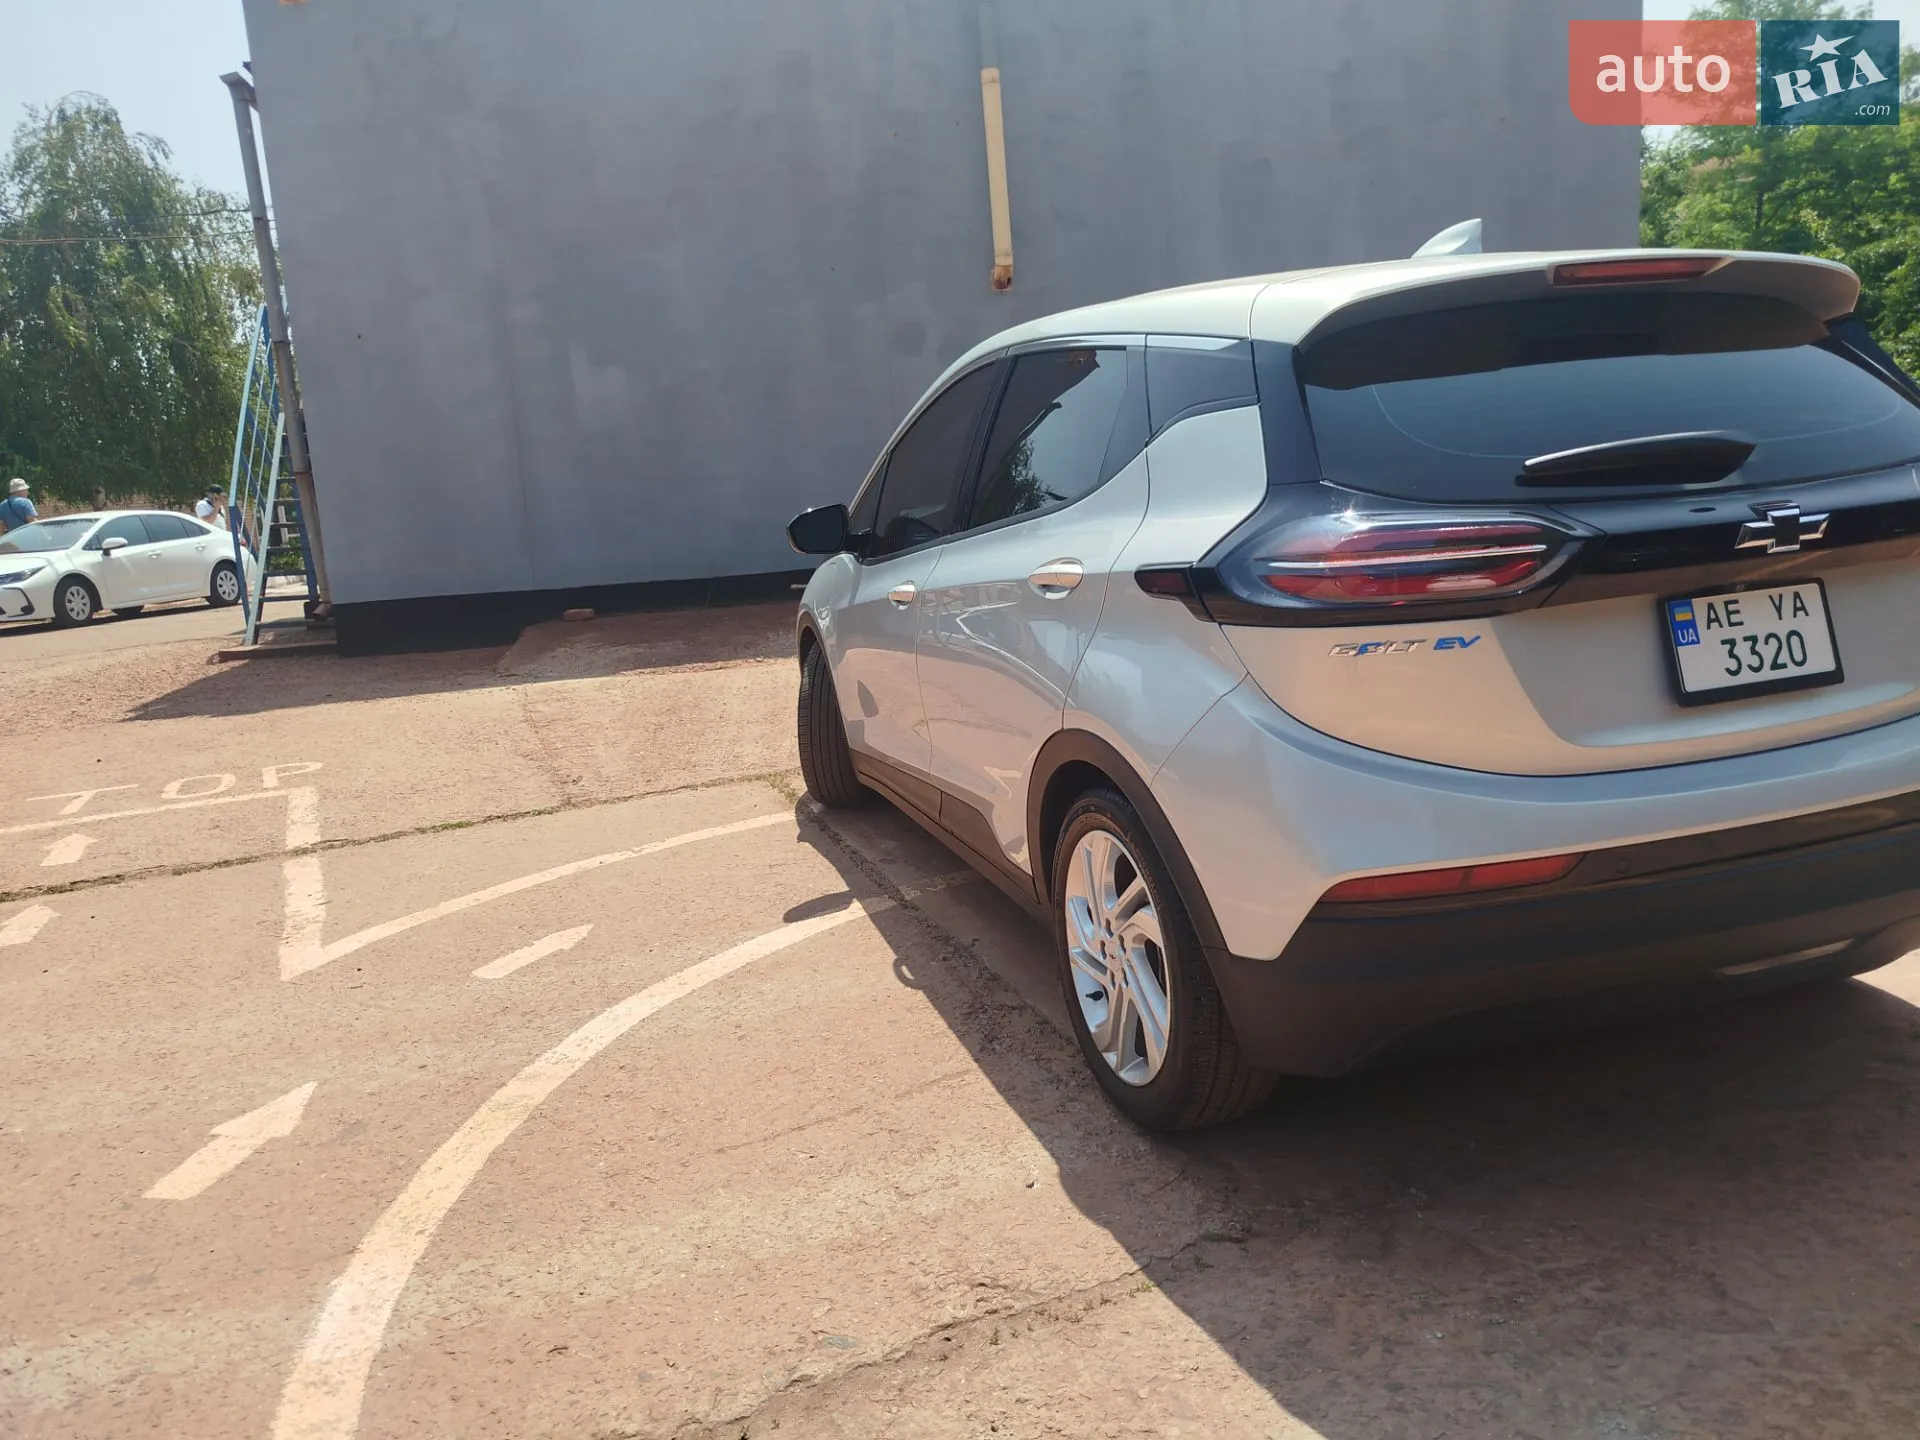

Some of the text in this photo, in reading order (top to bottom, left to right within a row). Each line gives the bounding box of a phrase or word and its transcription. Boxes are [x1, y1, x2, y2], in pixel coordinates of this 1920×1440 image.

[1706, 591, 1810, 630] AE YA
[1328, 635, 1481, 657] BOLT EV
[1678, 628, 1698, 644] UA
[1720, 630, 1808, 677] 3320
